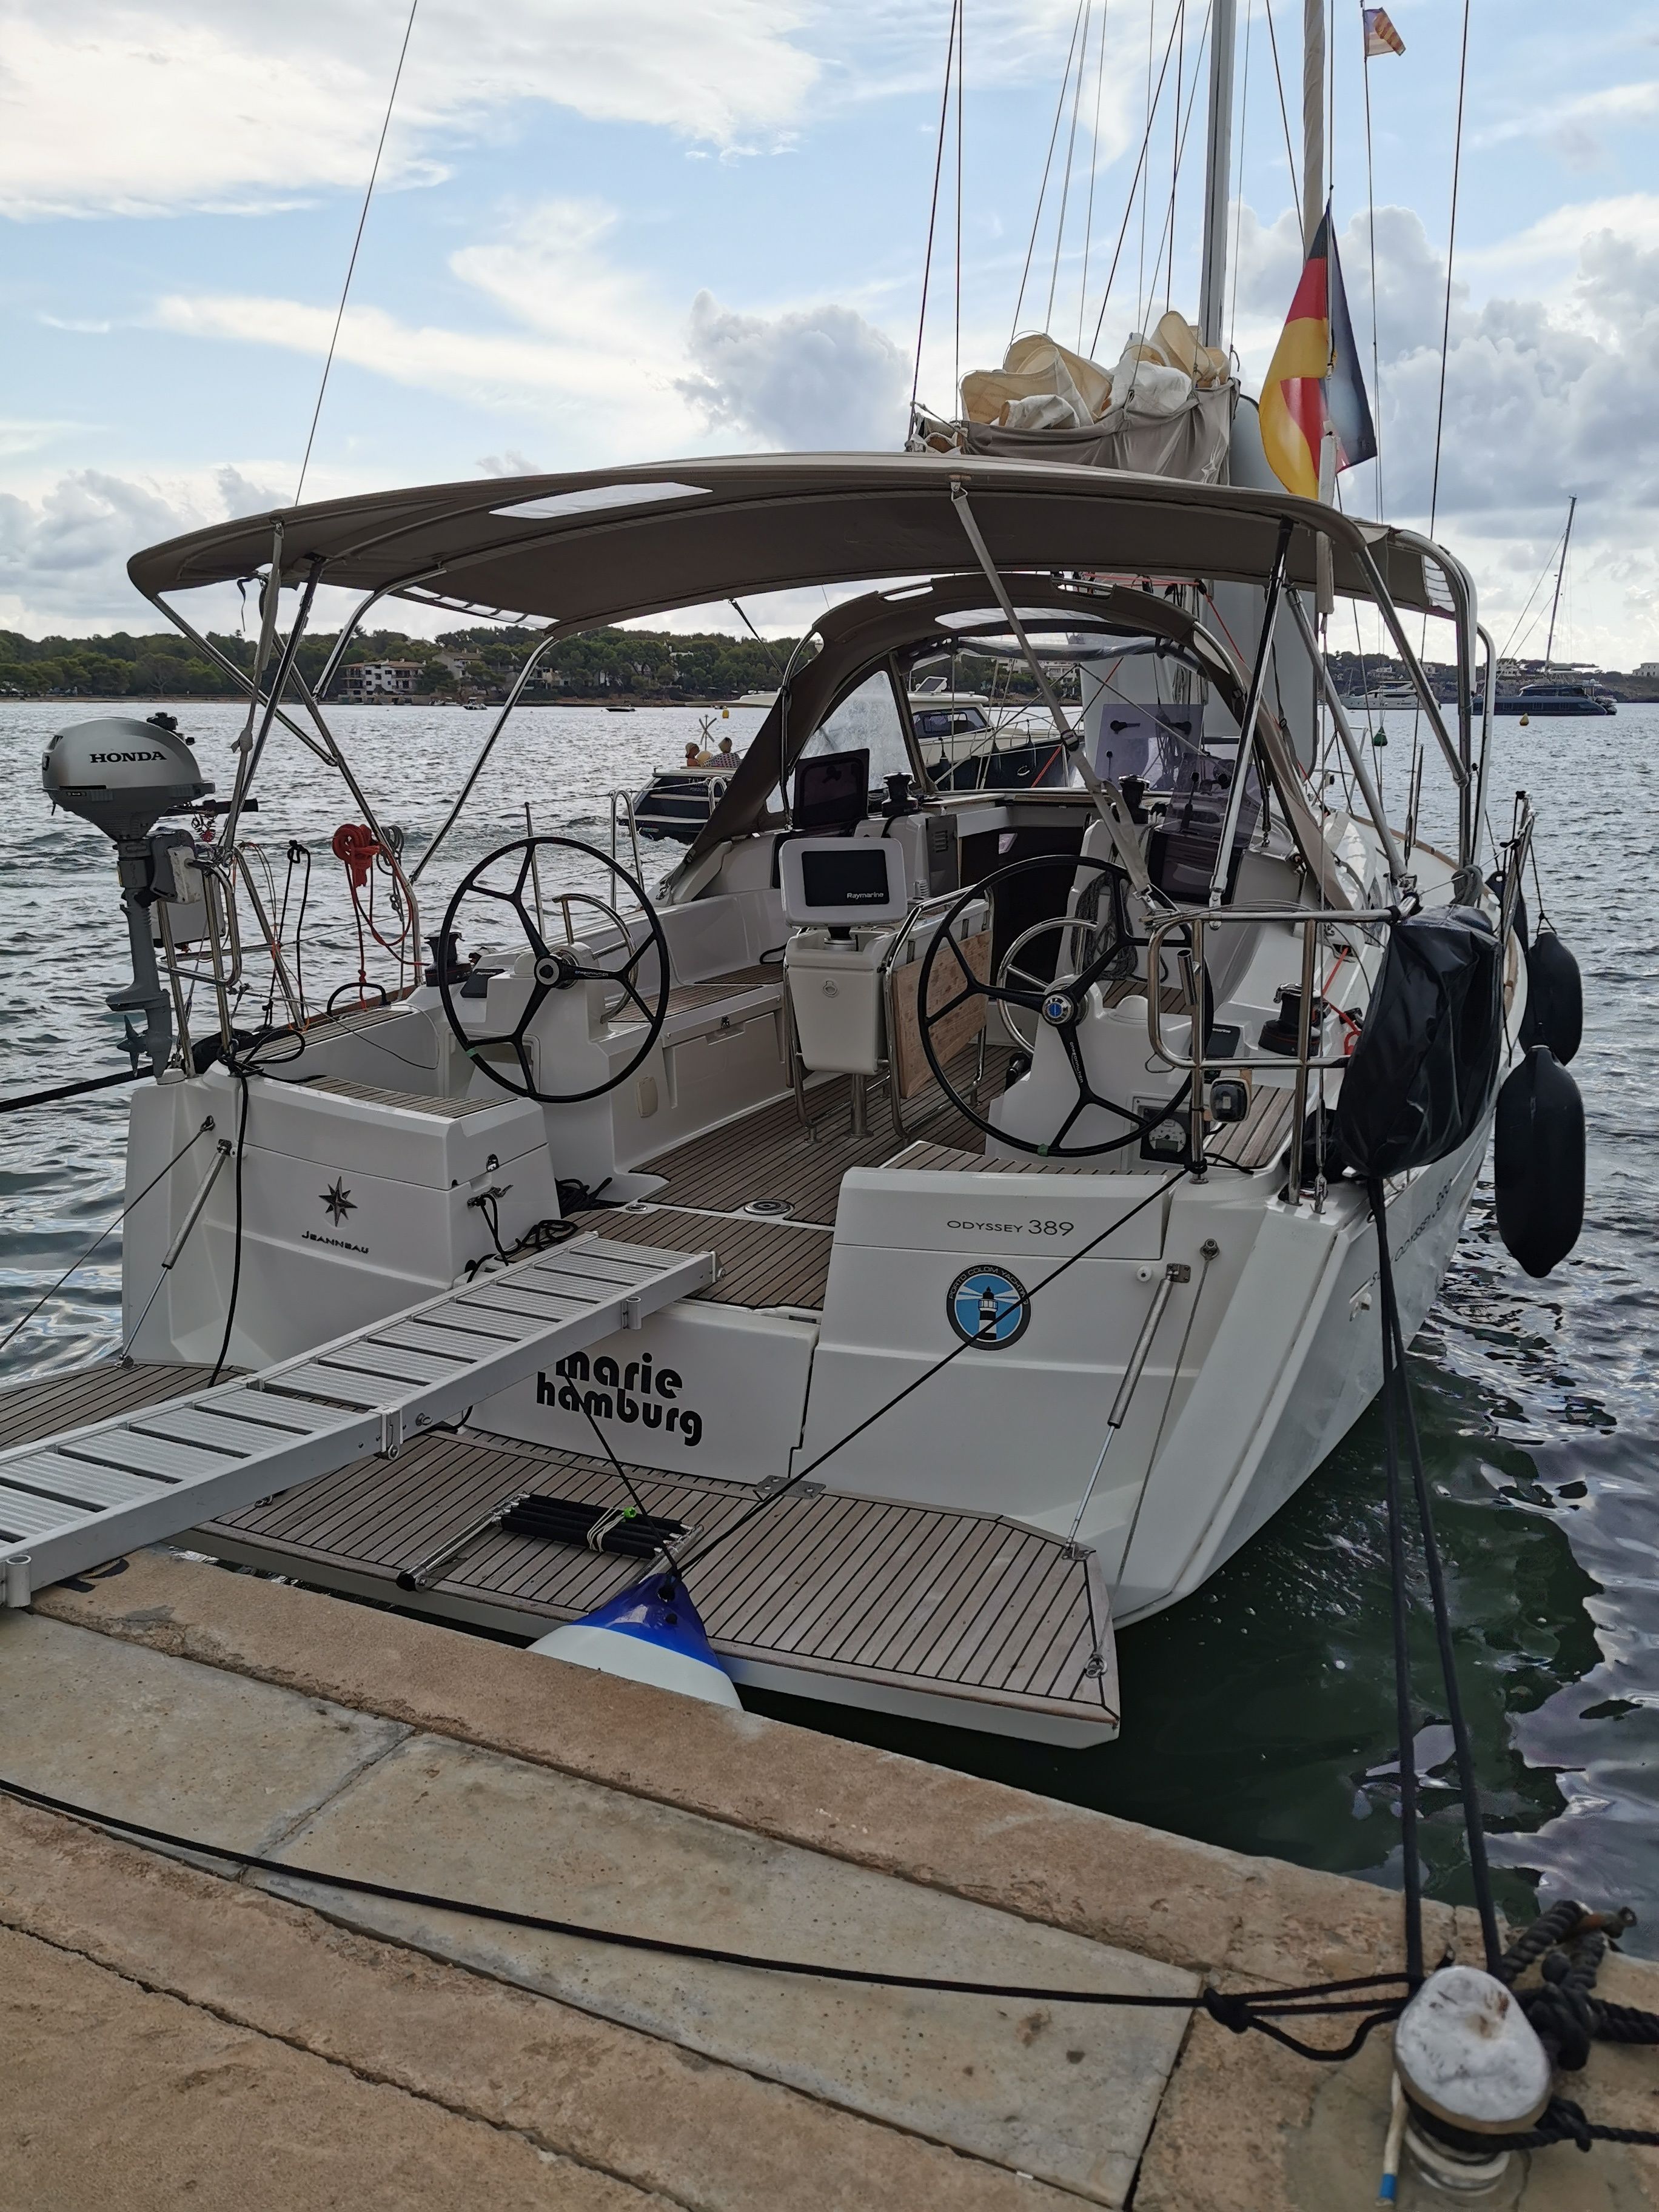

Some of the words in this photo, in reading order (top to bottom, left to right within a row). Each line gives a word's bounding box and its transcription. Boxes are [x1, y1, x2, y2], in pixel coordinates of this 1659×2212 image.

[89, 751, 167, 763] HONDA
[846, 891, 884, 900] Raymarine
[947, 1221, 1023, 1233] ODYSSEY
[1028, 1219, 1074, 1236] 389
[948, 1274, 967, 1299] PORTO
[968, 1267, 999, 1276] COLOM
[556, 1351, 682, 1399] marie
[537, 1372, 702, 1447] hamburg
